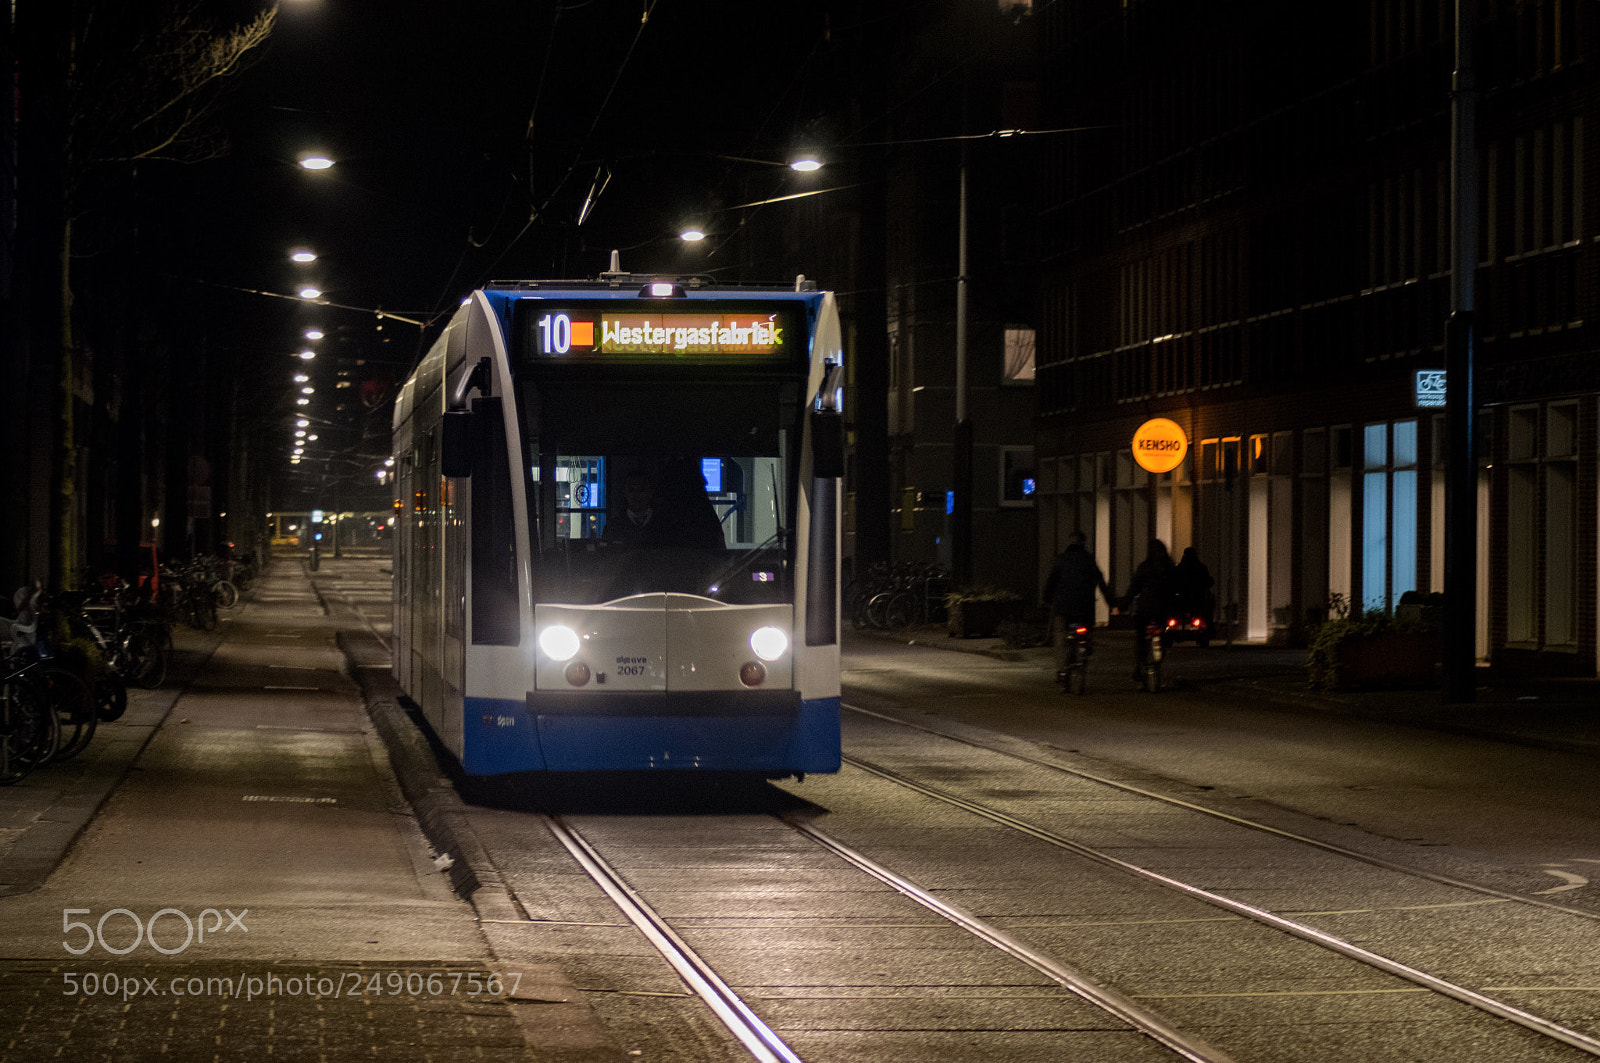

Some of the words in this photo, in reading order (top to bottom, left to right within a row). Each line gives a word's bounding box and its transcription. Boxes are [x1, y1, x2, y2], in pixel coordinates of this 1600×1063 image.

[538, 314, 571, 354] 10
[602, 319, 783, 349] Westergasfabriek
[1138, 439, 1181, 451] KENSHO
[617, 665, 645, 676] 2067
